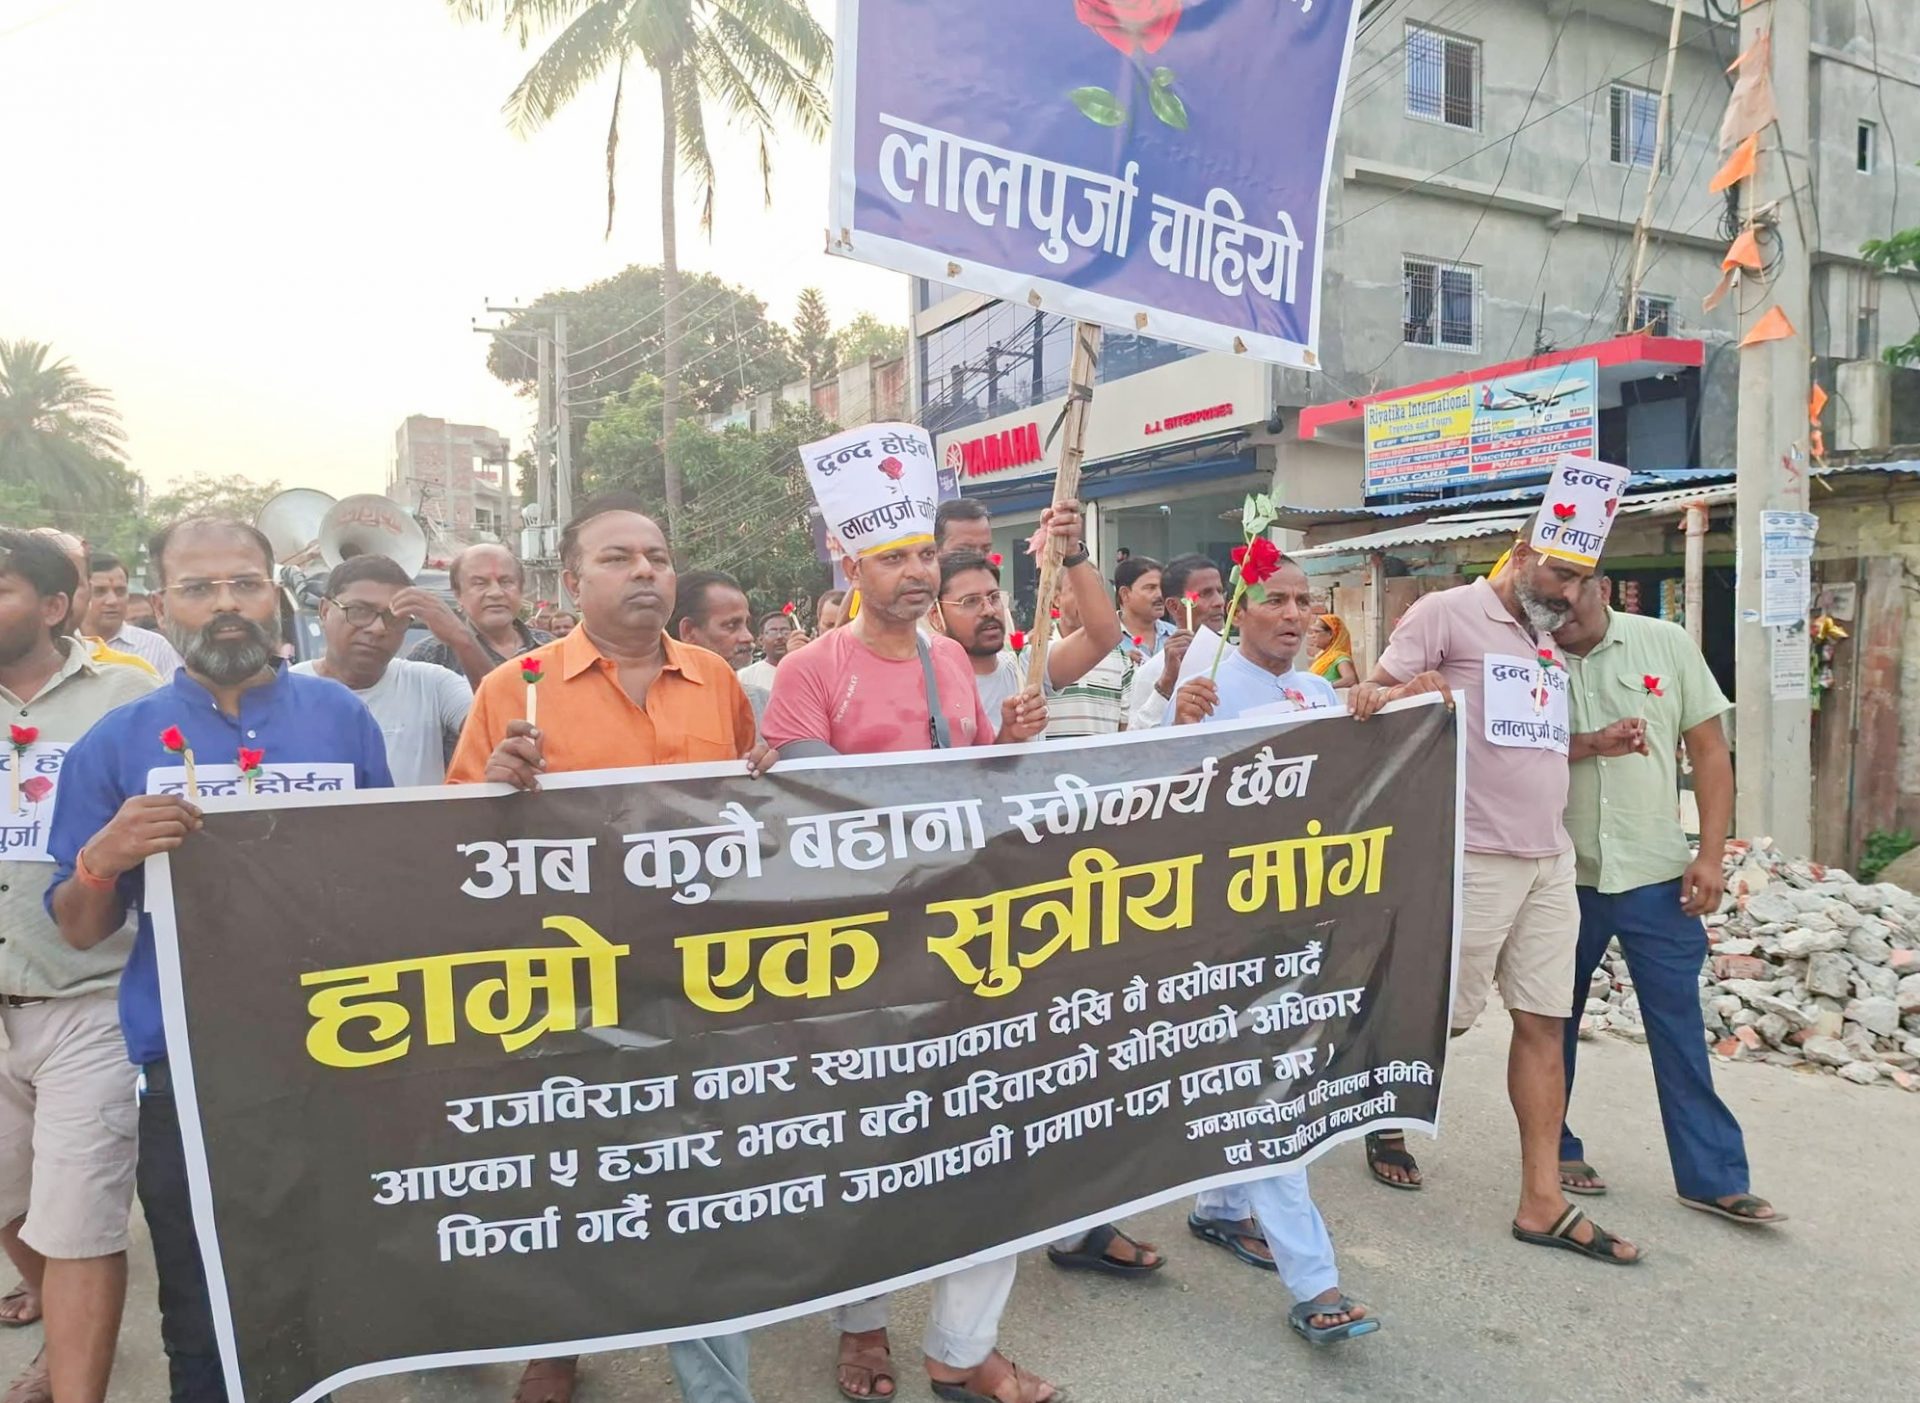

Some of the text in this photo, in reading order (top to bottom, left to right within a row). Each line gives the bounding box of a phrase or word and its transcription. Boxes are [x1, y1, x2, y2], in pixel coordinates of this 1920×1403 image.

[879, 112, 1304, 304] लालपुर्जा चाहियो
[961, 422, 1043, 477] YAMAHA
[1369, 389, 1471, 428] Riyatika International
[1472, 449, 1519, 462] Vaccine
[1522, 439, 1591, 455] Certificate
[1383, 474, 1410, 484] PAN
[1411, 470, 1449, 481] CARD
[456, 746, 1318, 905] अब कुनै बहाना स्वीकार्य छैन
[300, 819, 1393, 1068] हाम्रो एक सुत्रीय मांग
[371, 987, 1365, 1205] आएका ५ हजार भन्दा बढी परिवारको खोसिएको अधिकार
[445, 940, 1323, 1133] राजविराज नगर स्थापनाकाल देखि नै बसोबास गर्दै
[437, 1205, 561, 1262] फिर्ता
[576, 1193, 652, 1241] गर्दै
[666, 1174, 827, 1234] तत्काल
[839, 1124, 1014, 1202] जग्गाधनी
[1024, 1079, 1171, 1157] प्रमाण-पत्र
[1180, 1058, 1263, 1106] प्रदान
[1272, 1047, 1317, 1082] गर
[1185, 1060, 1434, 1140] जनआन्दोलन परिचालन समिति
[1224, 1091, 1398, 1166] एवं राजविराज नगरवासी
